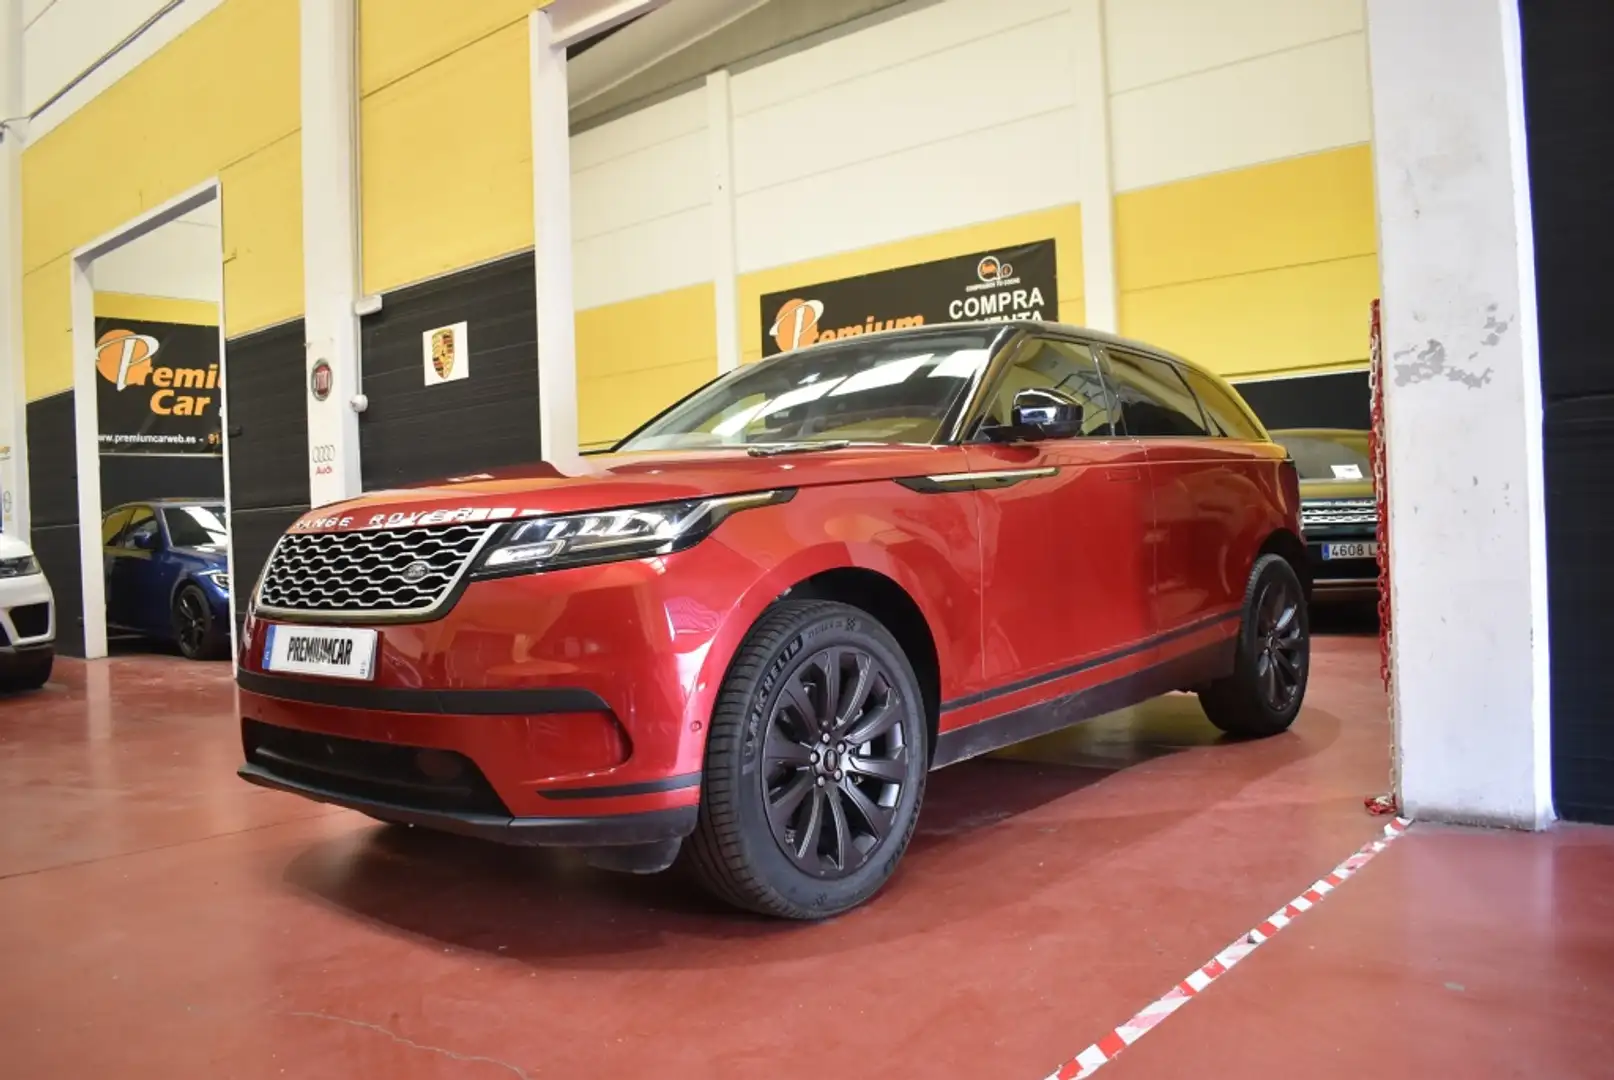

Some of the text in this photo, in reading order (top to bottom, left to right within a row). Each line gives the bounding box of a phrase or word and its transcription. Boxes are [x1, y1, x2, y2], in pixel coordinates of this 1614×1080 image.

[949, 287, 1045, 319] COMPRA
[95, 334, 222, 391] Premi
[150, 389, 211, 416] Car
[1331, 544, 1364, 556] 4608
[749, 639, 800, 737] MICHELIN
